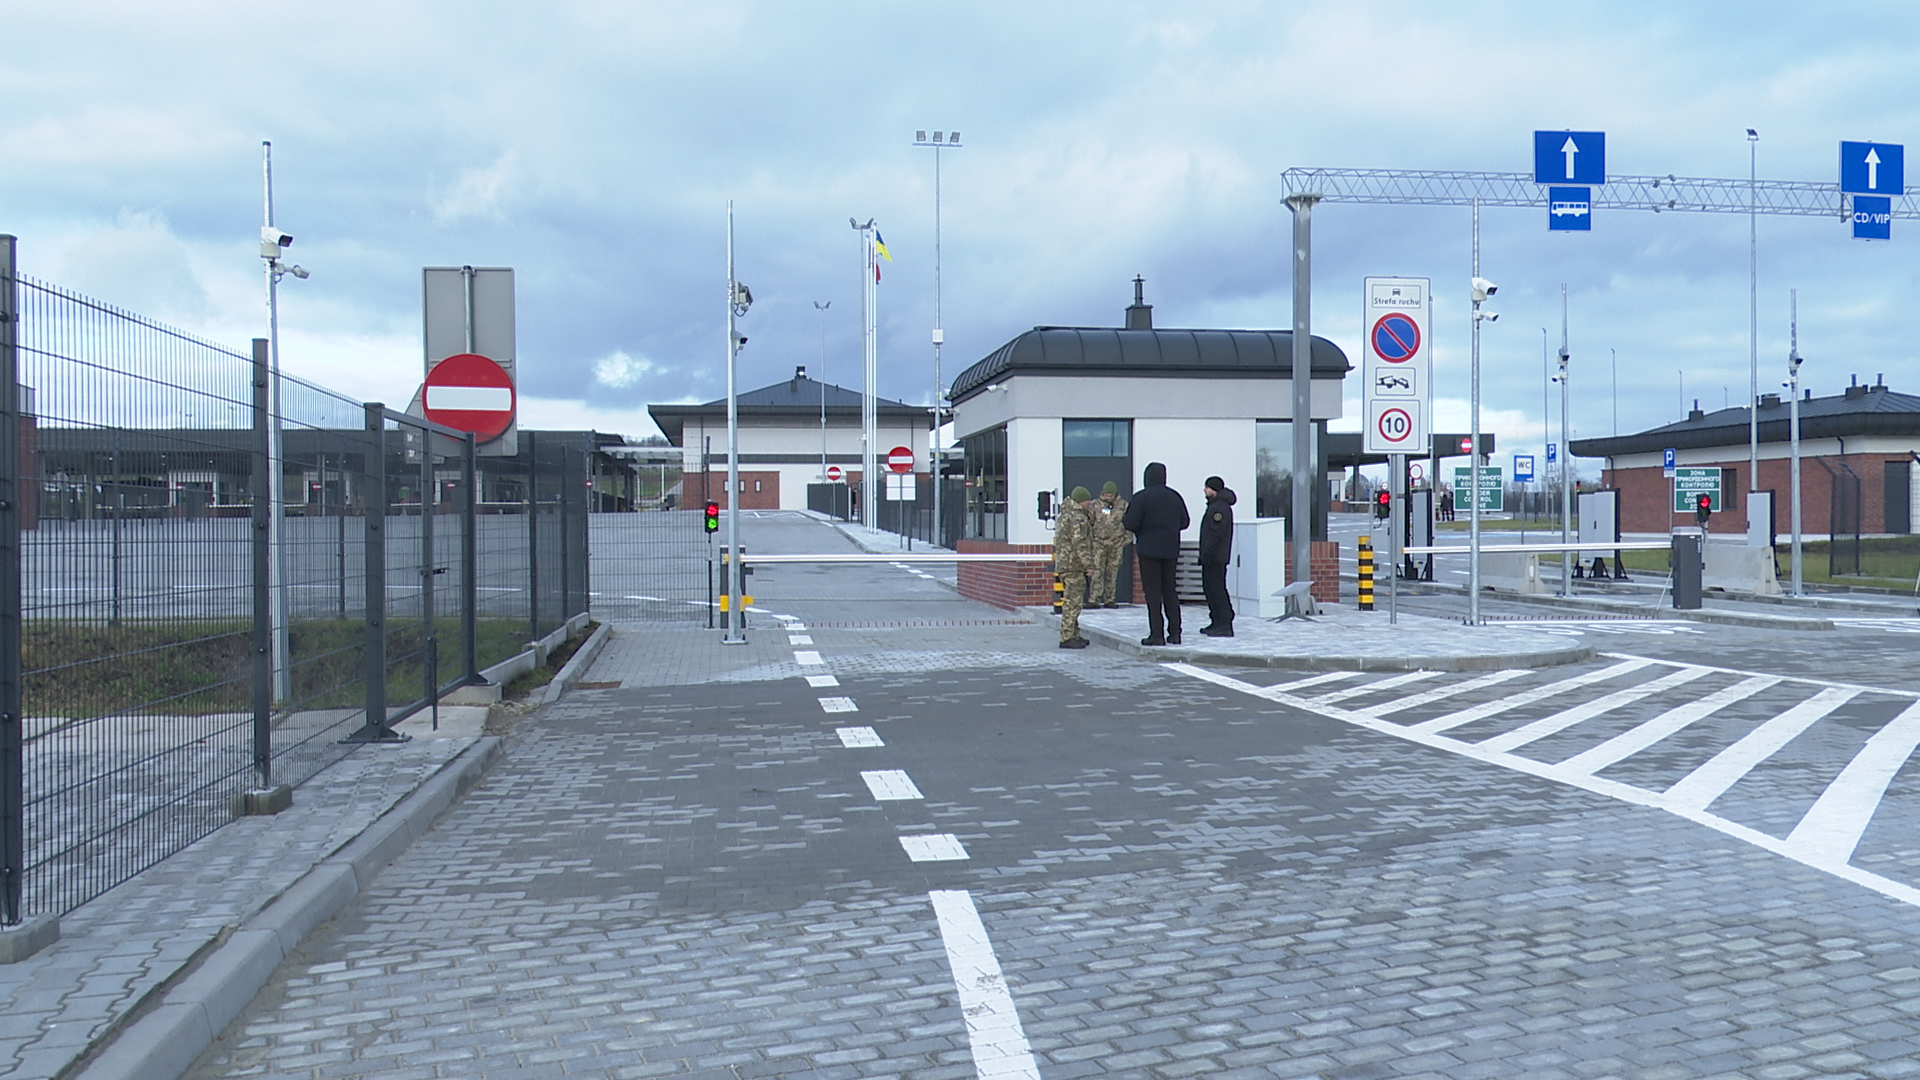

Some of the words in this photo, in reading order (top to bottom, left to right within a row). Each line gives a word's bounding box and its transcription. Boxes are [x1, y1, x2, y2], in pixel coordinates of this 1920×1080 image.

[1854, 212, 1890, 224] CD/VIP
[1374, 297, 1396, 305] Strefa
[1385, 417, 1405, 433] 10
[1549, 445, 1555, 457] P
[1666, 450, 1673, 464] P
